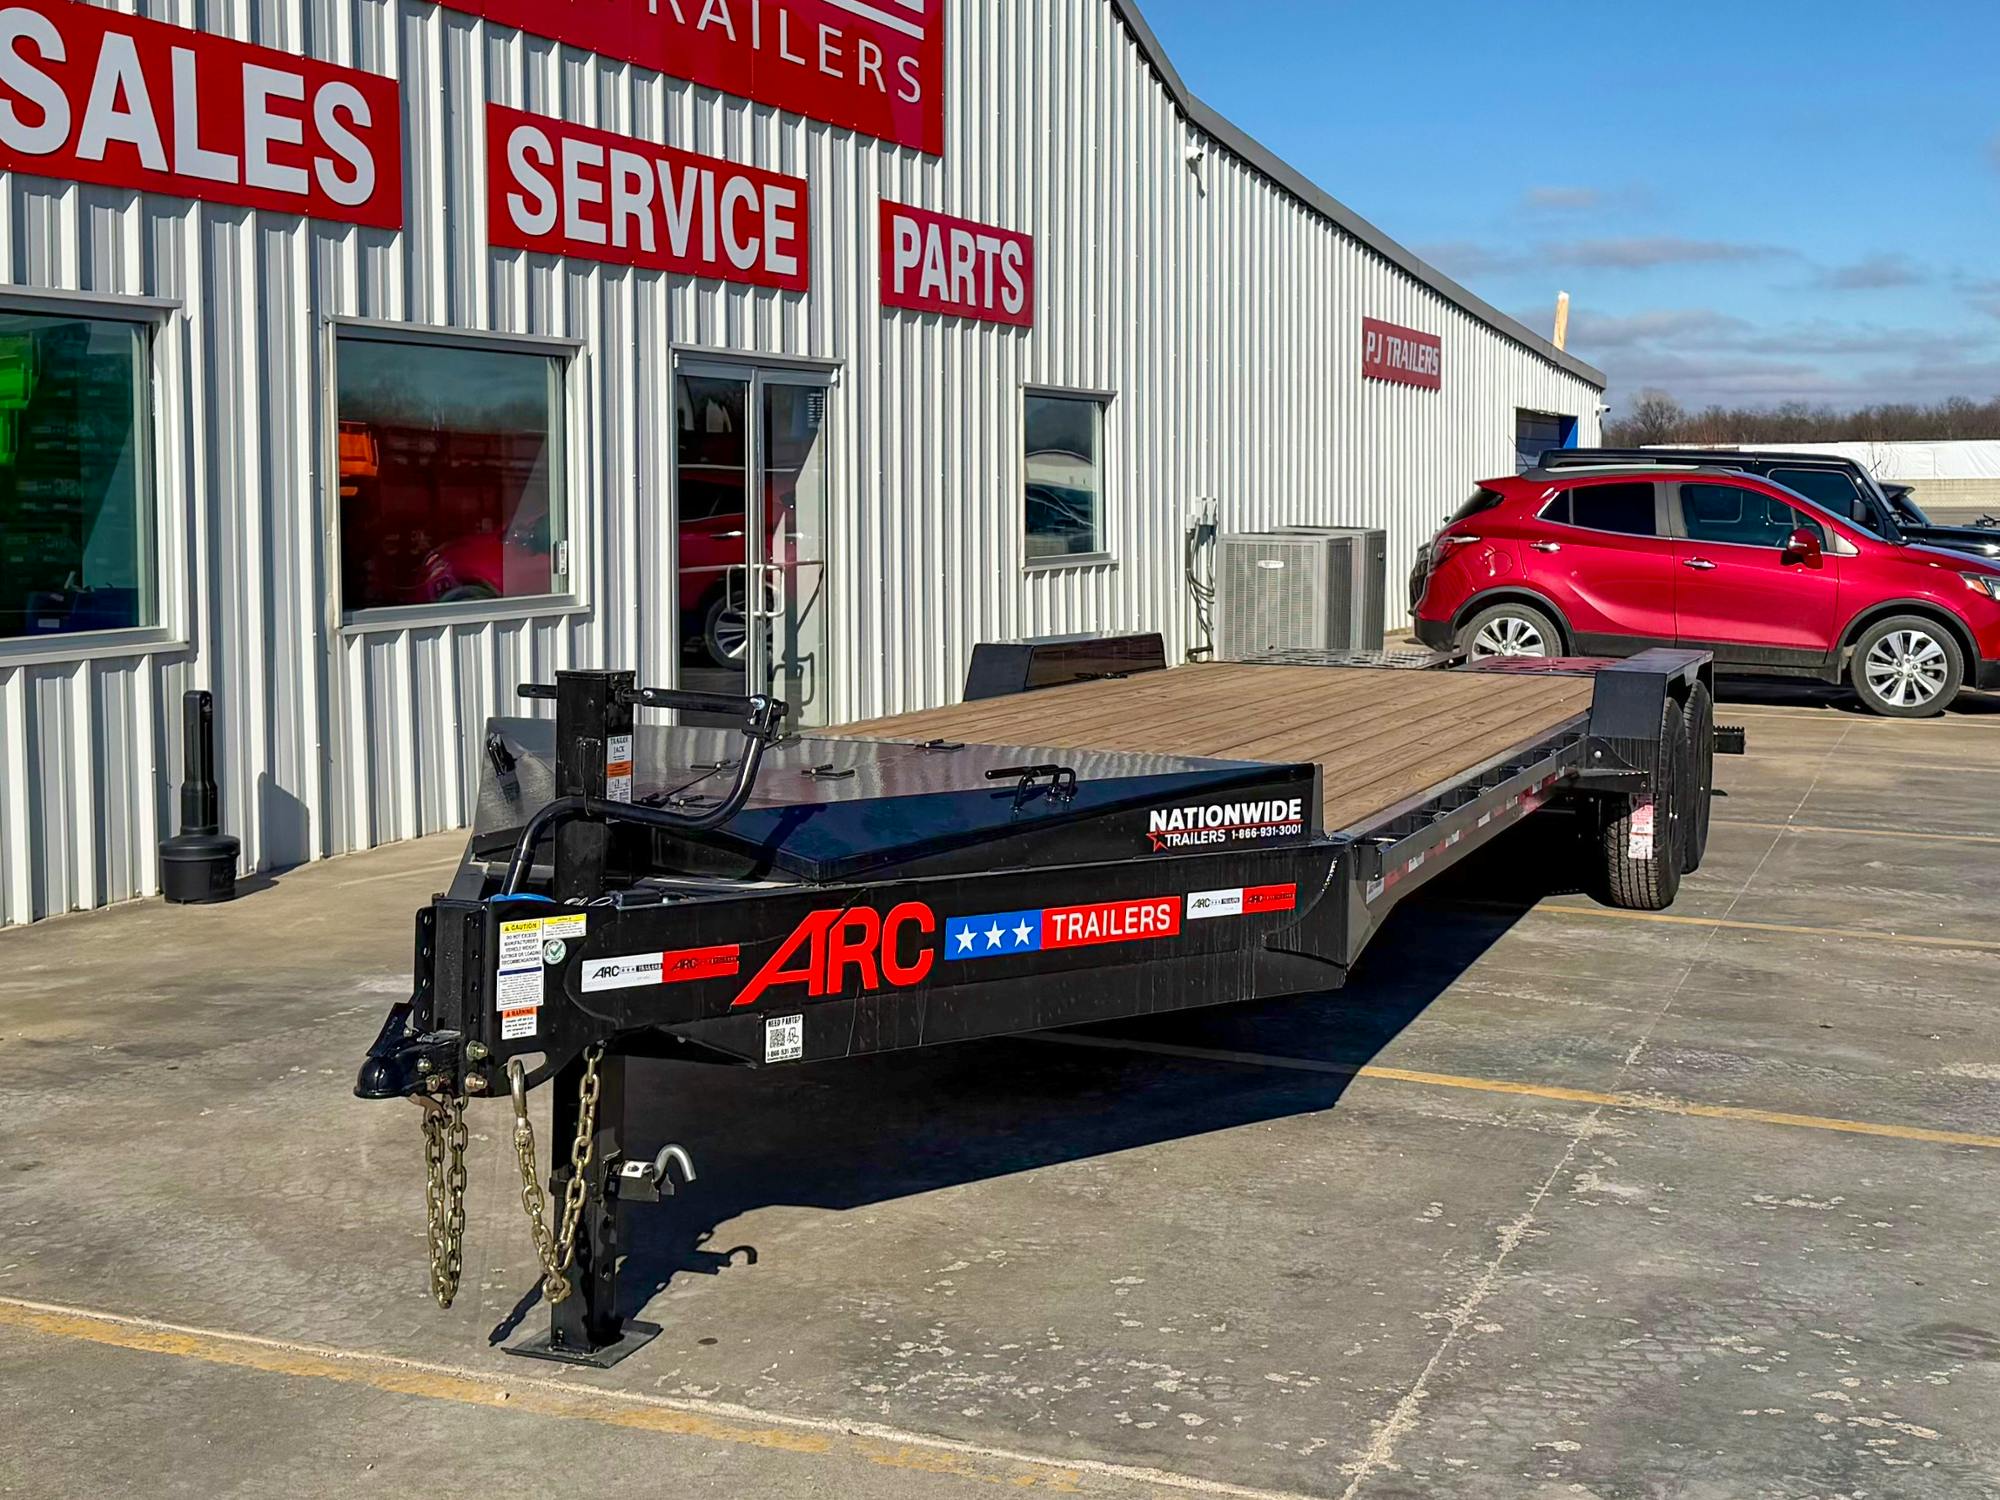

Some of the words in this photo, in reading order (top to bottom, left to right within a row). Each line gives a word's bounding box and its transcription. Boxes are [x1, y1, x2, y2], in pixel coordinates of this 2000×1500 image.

[0, 7, 376, 206] SALES
[506, 125, 798, 276] SERVICE
[893, 214, 1024, 315] PARTS
[1365, 331, 1383, 364] PJ
[1386, 336, 1440, 376] TRAILERS
[1149, 798, 1302, 832] NATIONWIDE
[1164, 830, 1226, 847] TRAILERS
[1232, 824, 1302, 839] 1-866-931-3001
[1191, 898, 1210, 909] ARC
[510, 923, 537, 931] CAUTION
[592, 965, 619, 979] ARC
[731, 902, 935, 1005] ARC
[1052, 904, 1171, 941] TRAILERS
